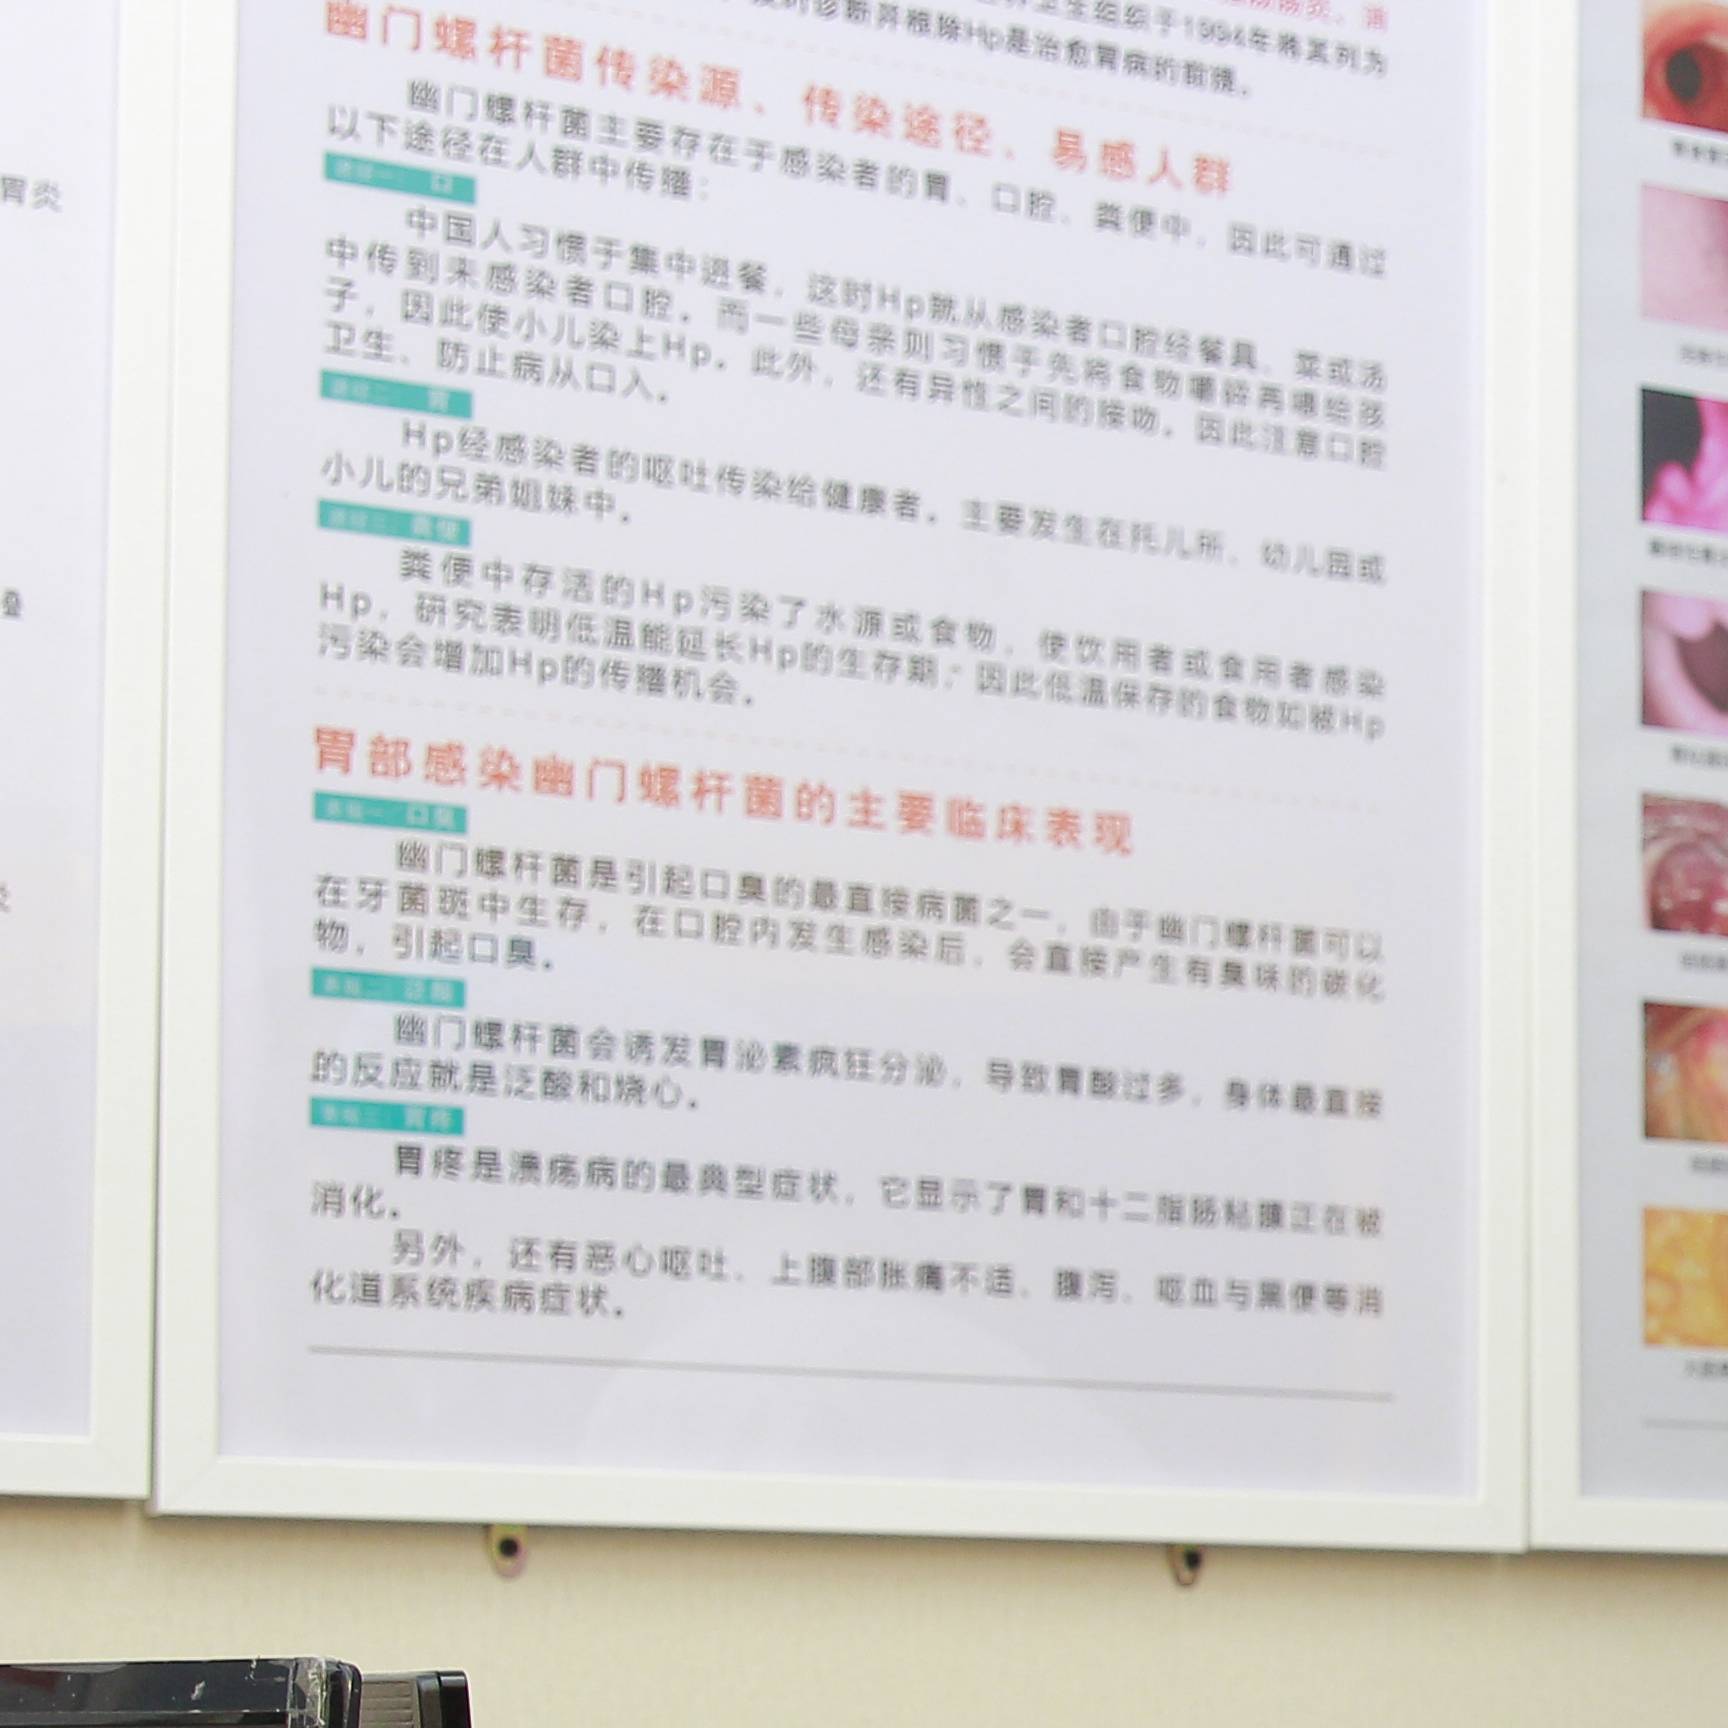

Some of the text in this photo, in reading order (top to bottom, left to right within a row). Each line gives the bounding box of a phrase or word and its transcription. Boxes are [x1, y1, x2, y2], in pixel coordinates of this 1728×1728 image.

[314, 725, 1134, 857] 胃部感染幽门螺杆菌的主要临床表现
